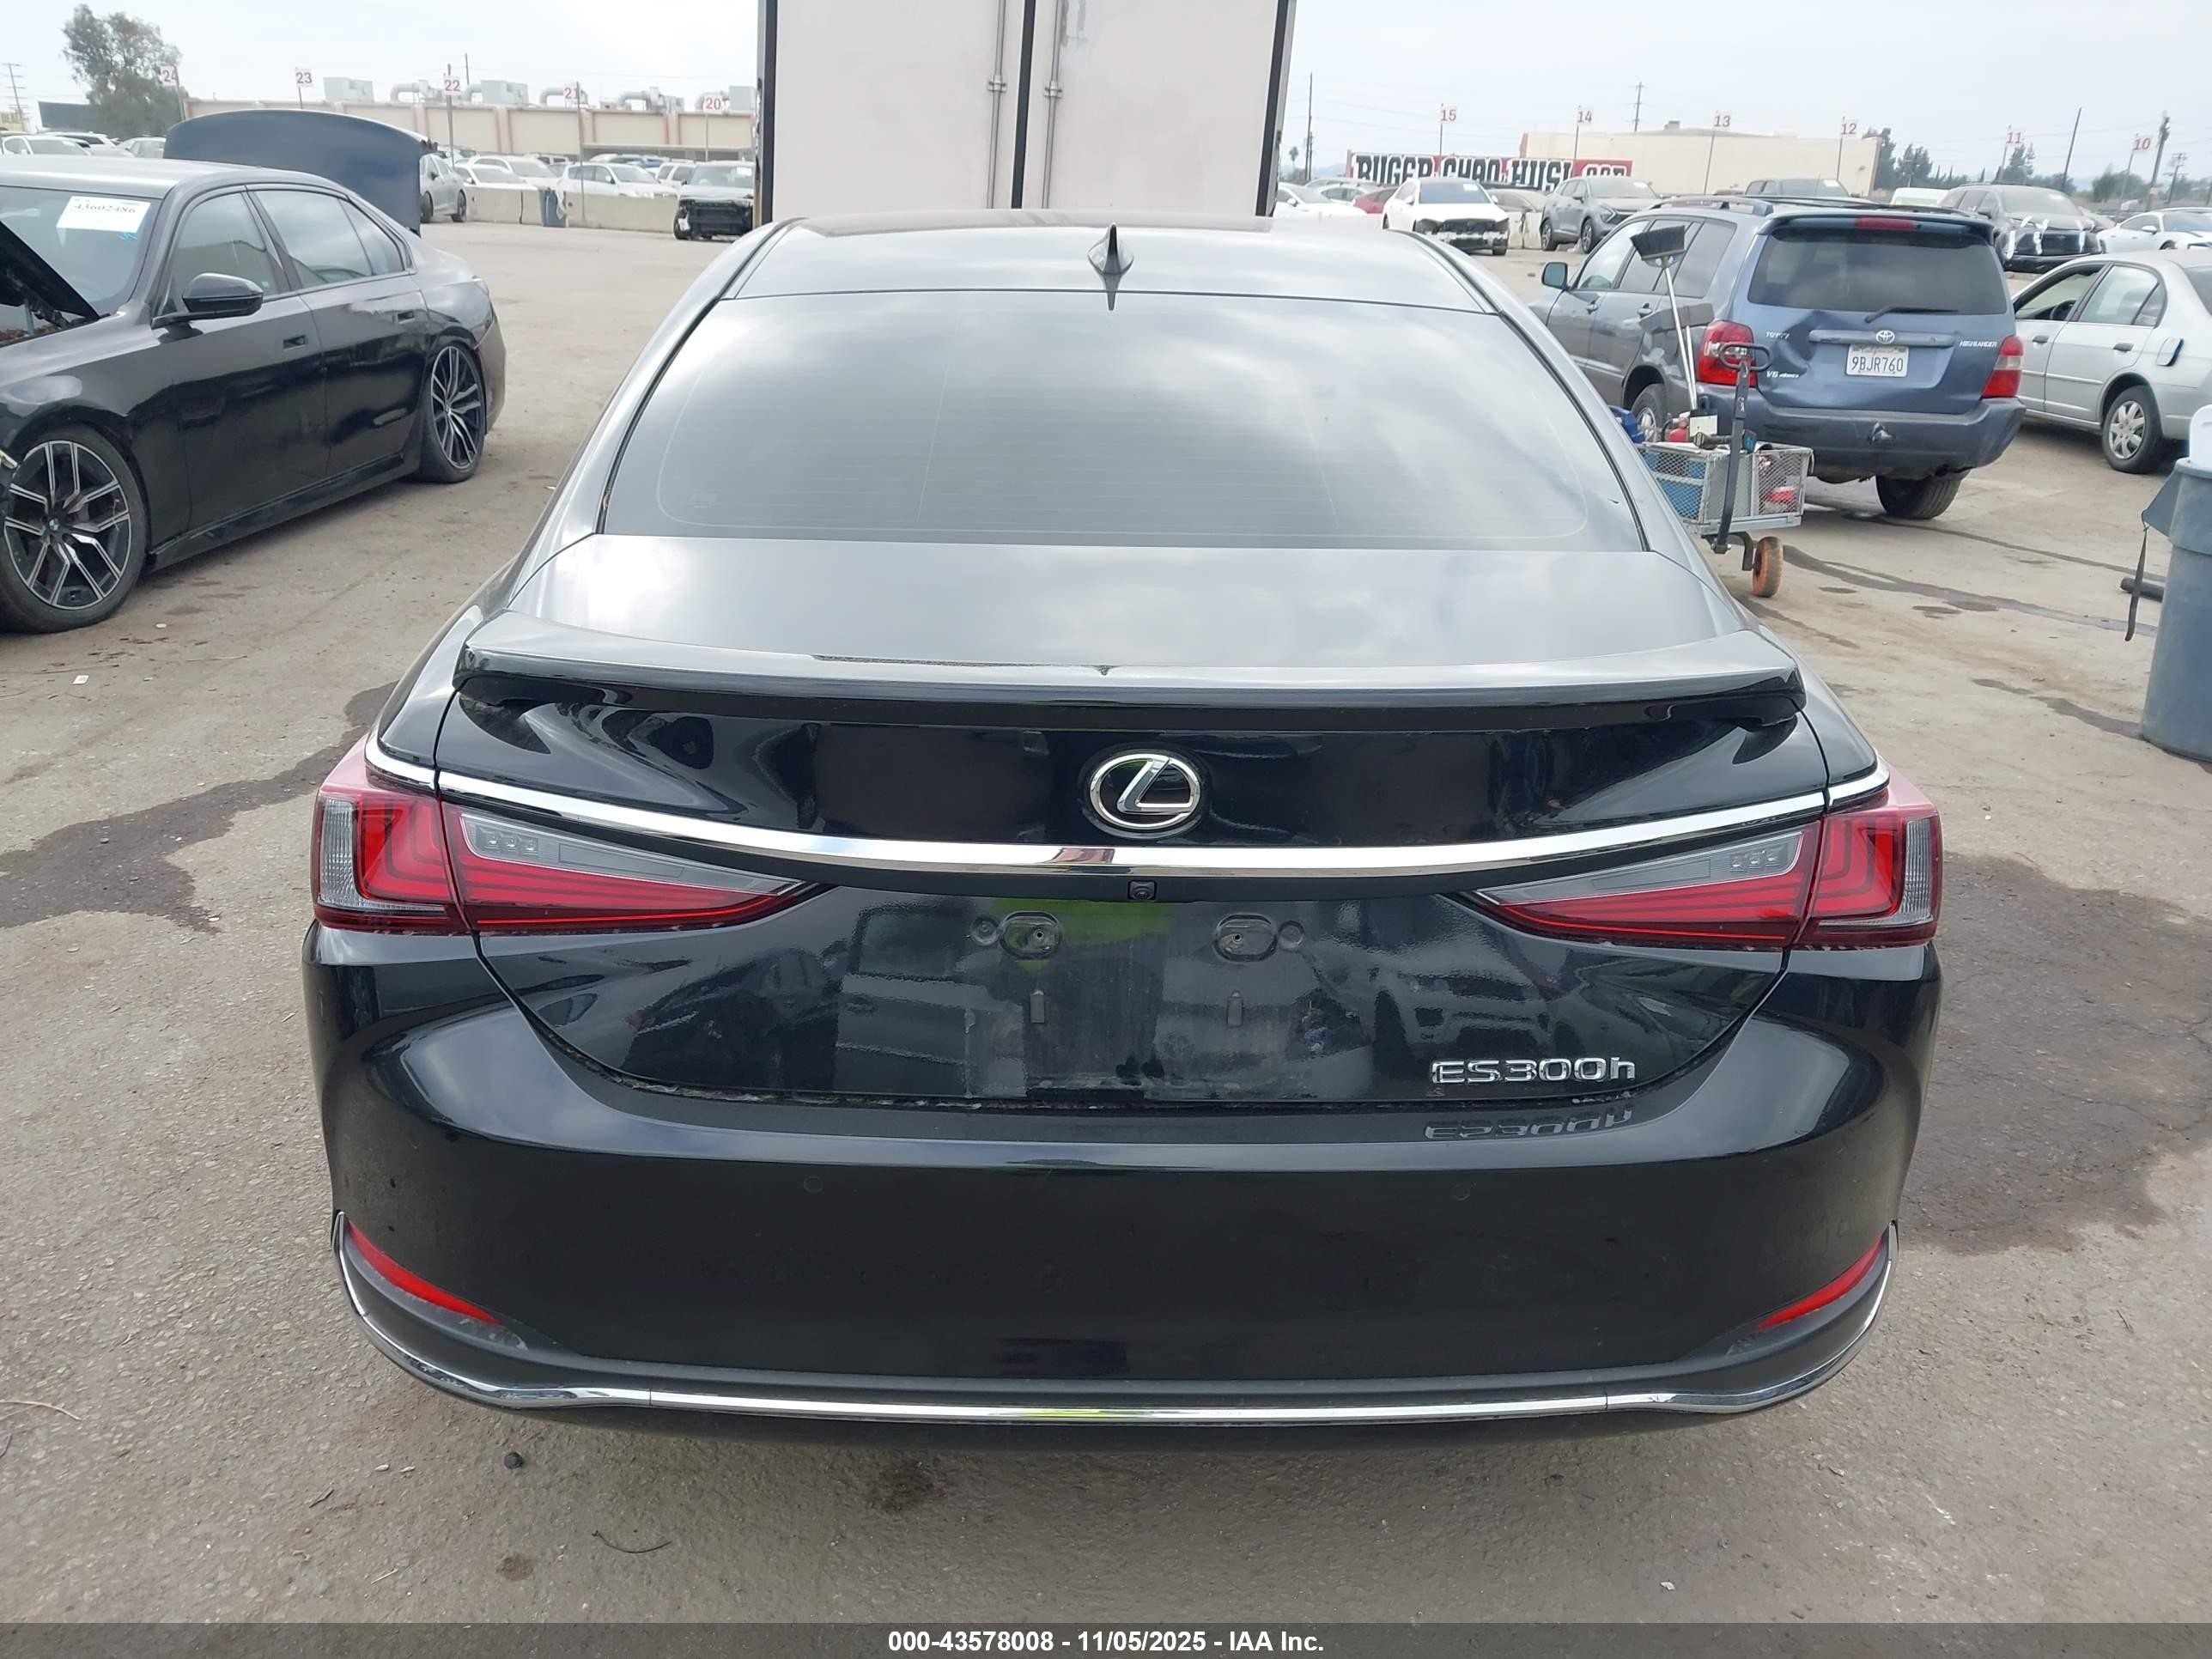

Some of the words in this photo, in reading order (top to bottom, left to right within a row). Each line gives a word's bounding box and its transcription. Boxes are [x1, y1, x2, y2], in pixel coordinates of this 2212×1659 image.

[296, 72, 313, 84] 23
[445, 80, 460, 92] 22
[706, 97, 721, 110] 20
[1441, 109, 1456, 121] 15
[1577, 111, 1592, 123] 14
[1714, 115, 1731, 128] 13
[1841, 123, 1856, 135] 12
[2006, 131, 2021, 143] 11
[2134, 137, 2151, 150] 10
[1851, 356, 1904, 372] 9BJR760
[1431, 1056, 1636, 1084] ES300h
